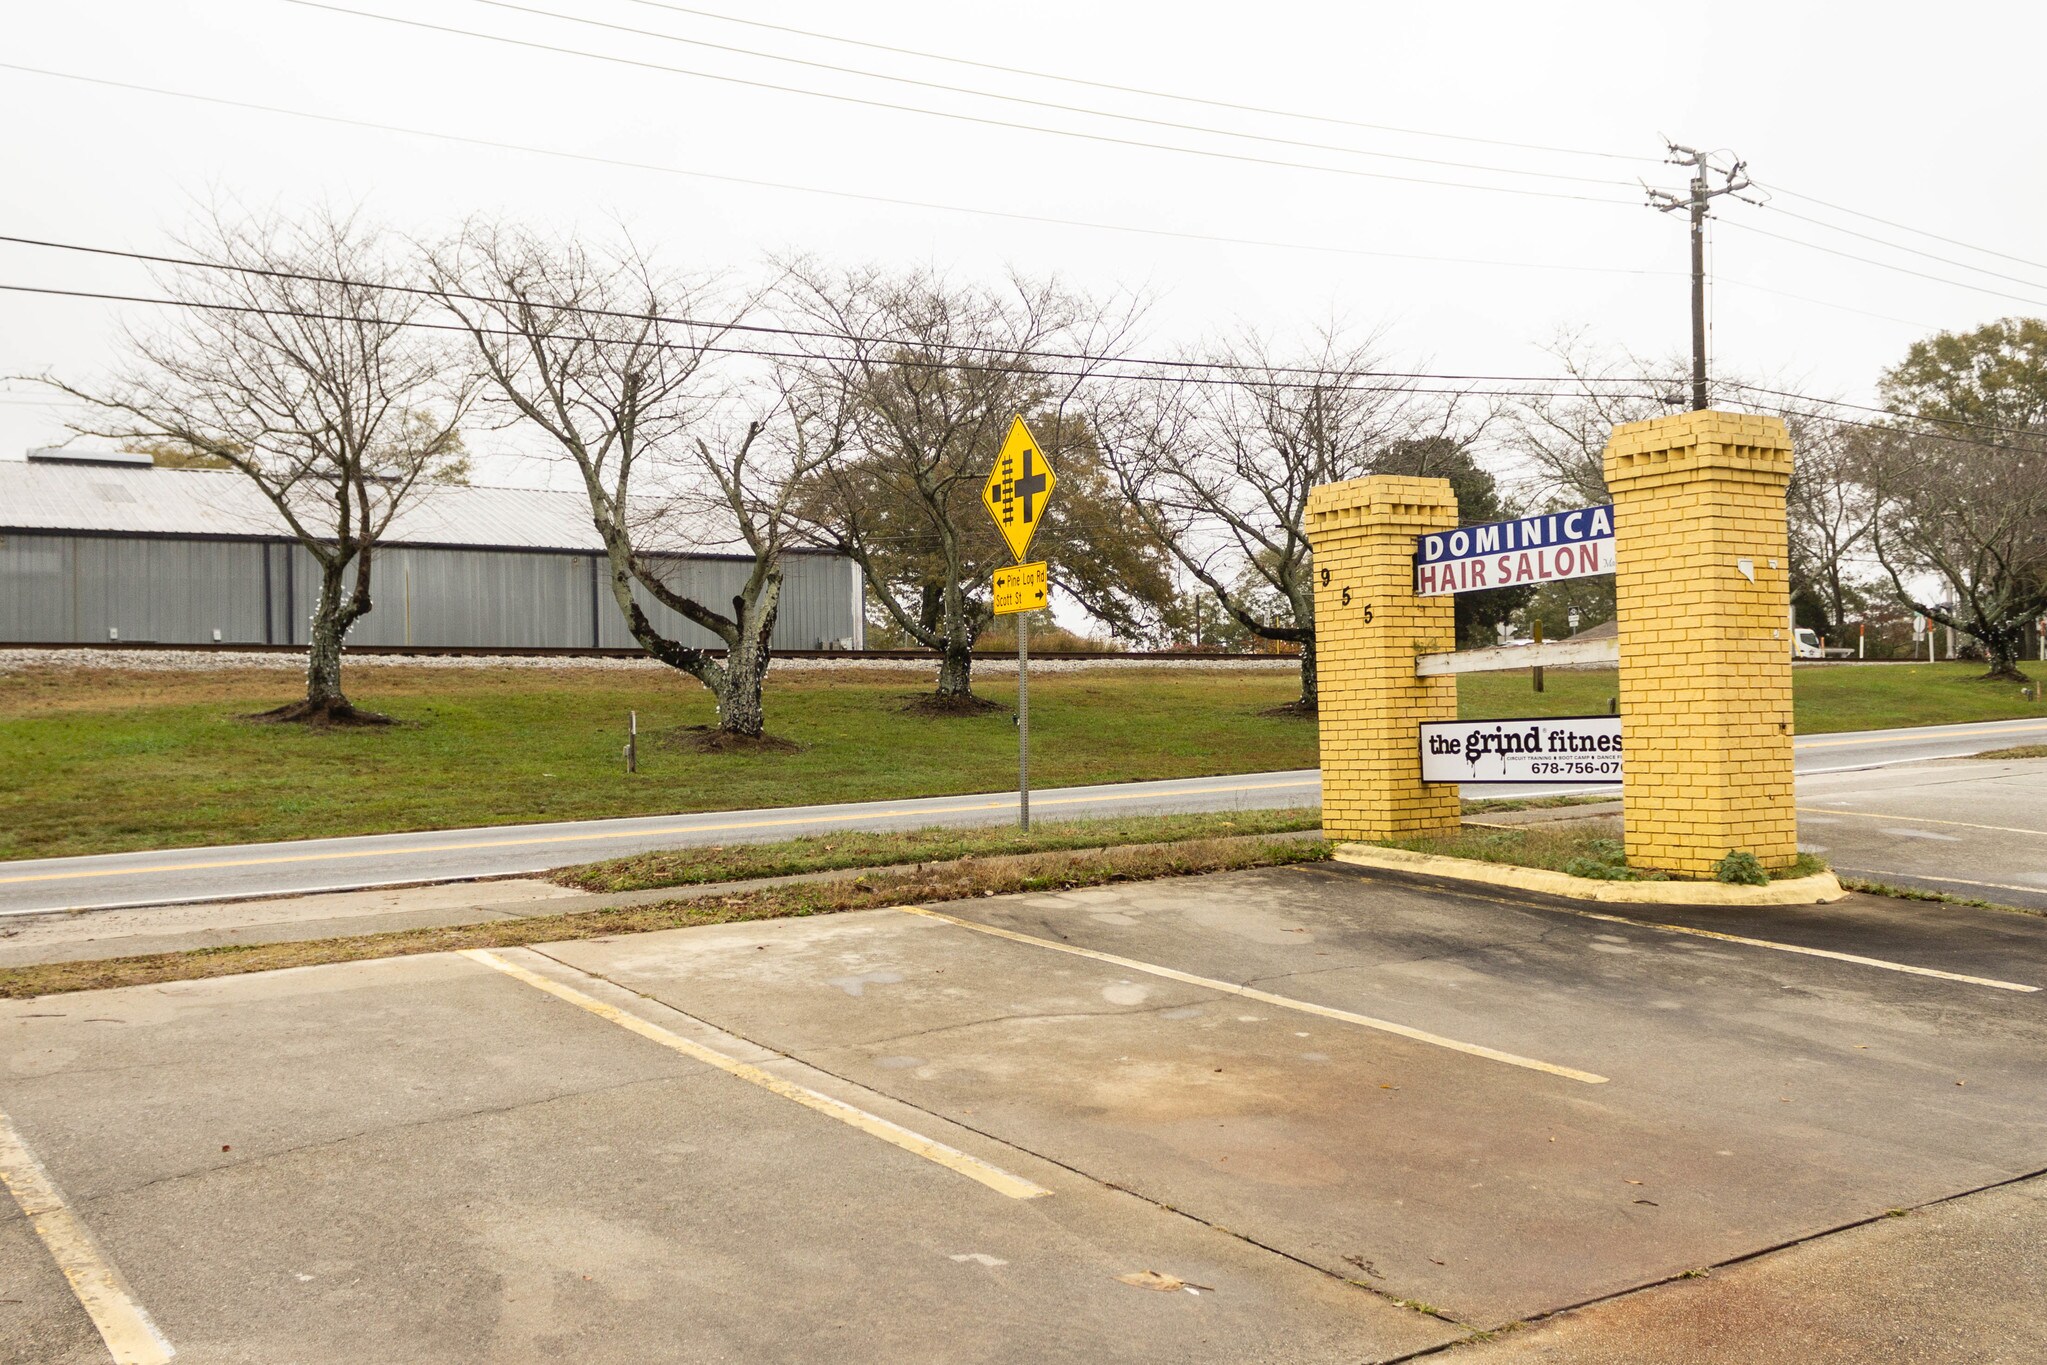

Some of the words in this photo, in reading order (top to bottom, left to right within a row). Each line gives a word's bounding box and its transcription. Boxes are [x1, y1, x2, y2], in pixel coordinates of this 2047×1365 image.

[1425, 508, 1612, 562] DOMINICA
[1007, 574, 1020, 587] Pine
[1023, 572, 1034, 586] Log
[1037, 570, 1044, 583] Rd
[1420, 558, 1487, 593] HAIR
[1498, 542, 1599, 584] SALON
[996, 594, 1012, 607] Scott
[1015, 591, 1022, 605] St
[1429, 734, 1461, 755] the
[1465, 726, 1543, 765] grind
[1531, 762, 1623, 774] 678-756-07
